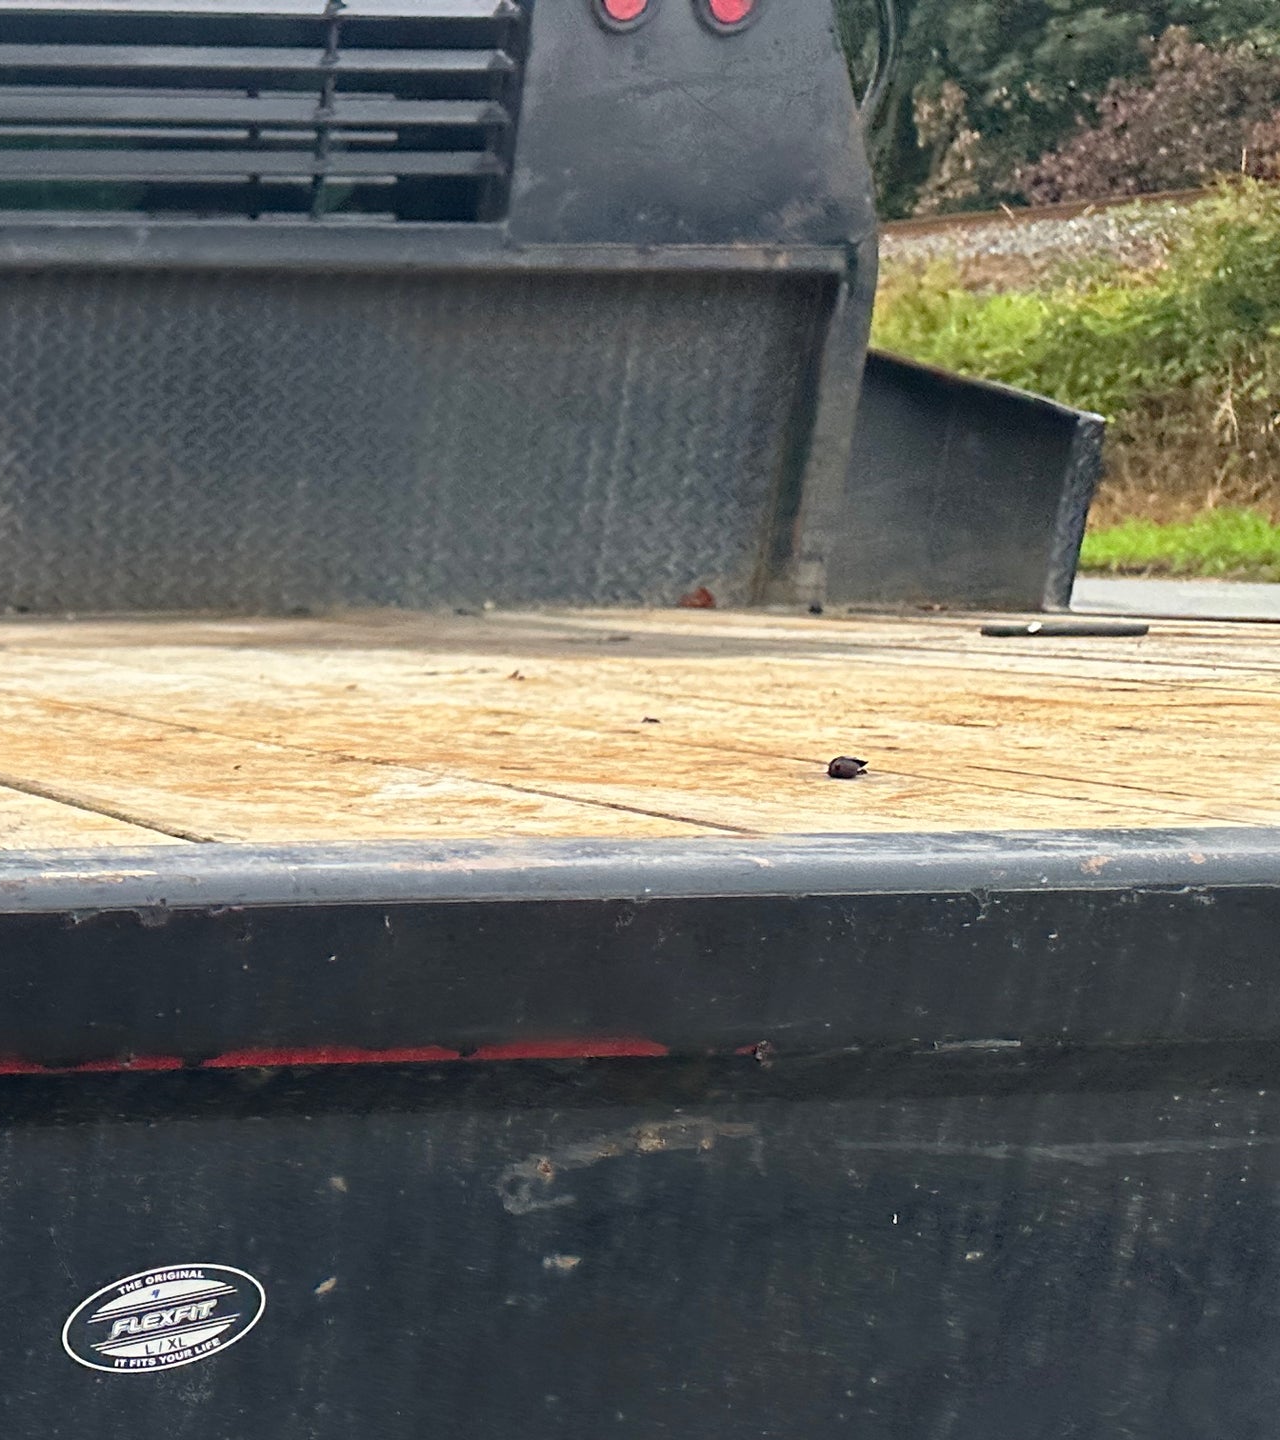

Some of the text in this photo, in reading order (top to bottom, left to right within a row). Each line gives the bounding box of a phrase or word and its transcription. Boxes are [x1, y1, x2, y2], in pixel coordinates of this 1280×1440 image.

[117, 1270, 204, 1295] THE ORIGINAL
[108, 1299, 218, 1340] FLEXFIT
[114, 1337, 221, 1367] IT FITS YOUR LIFE
